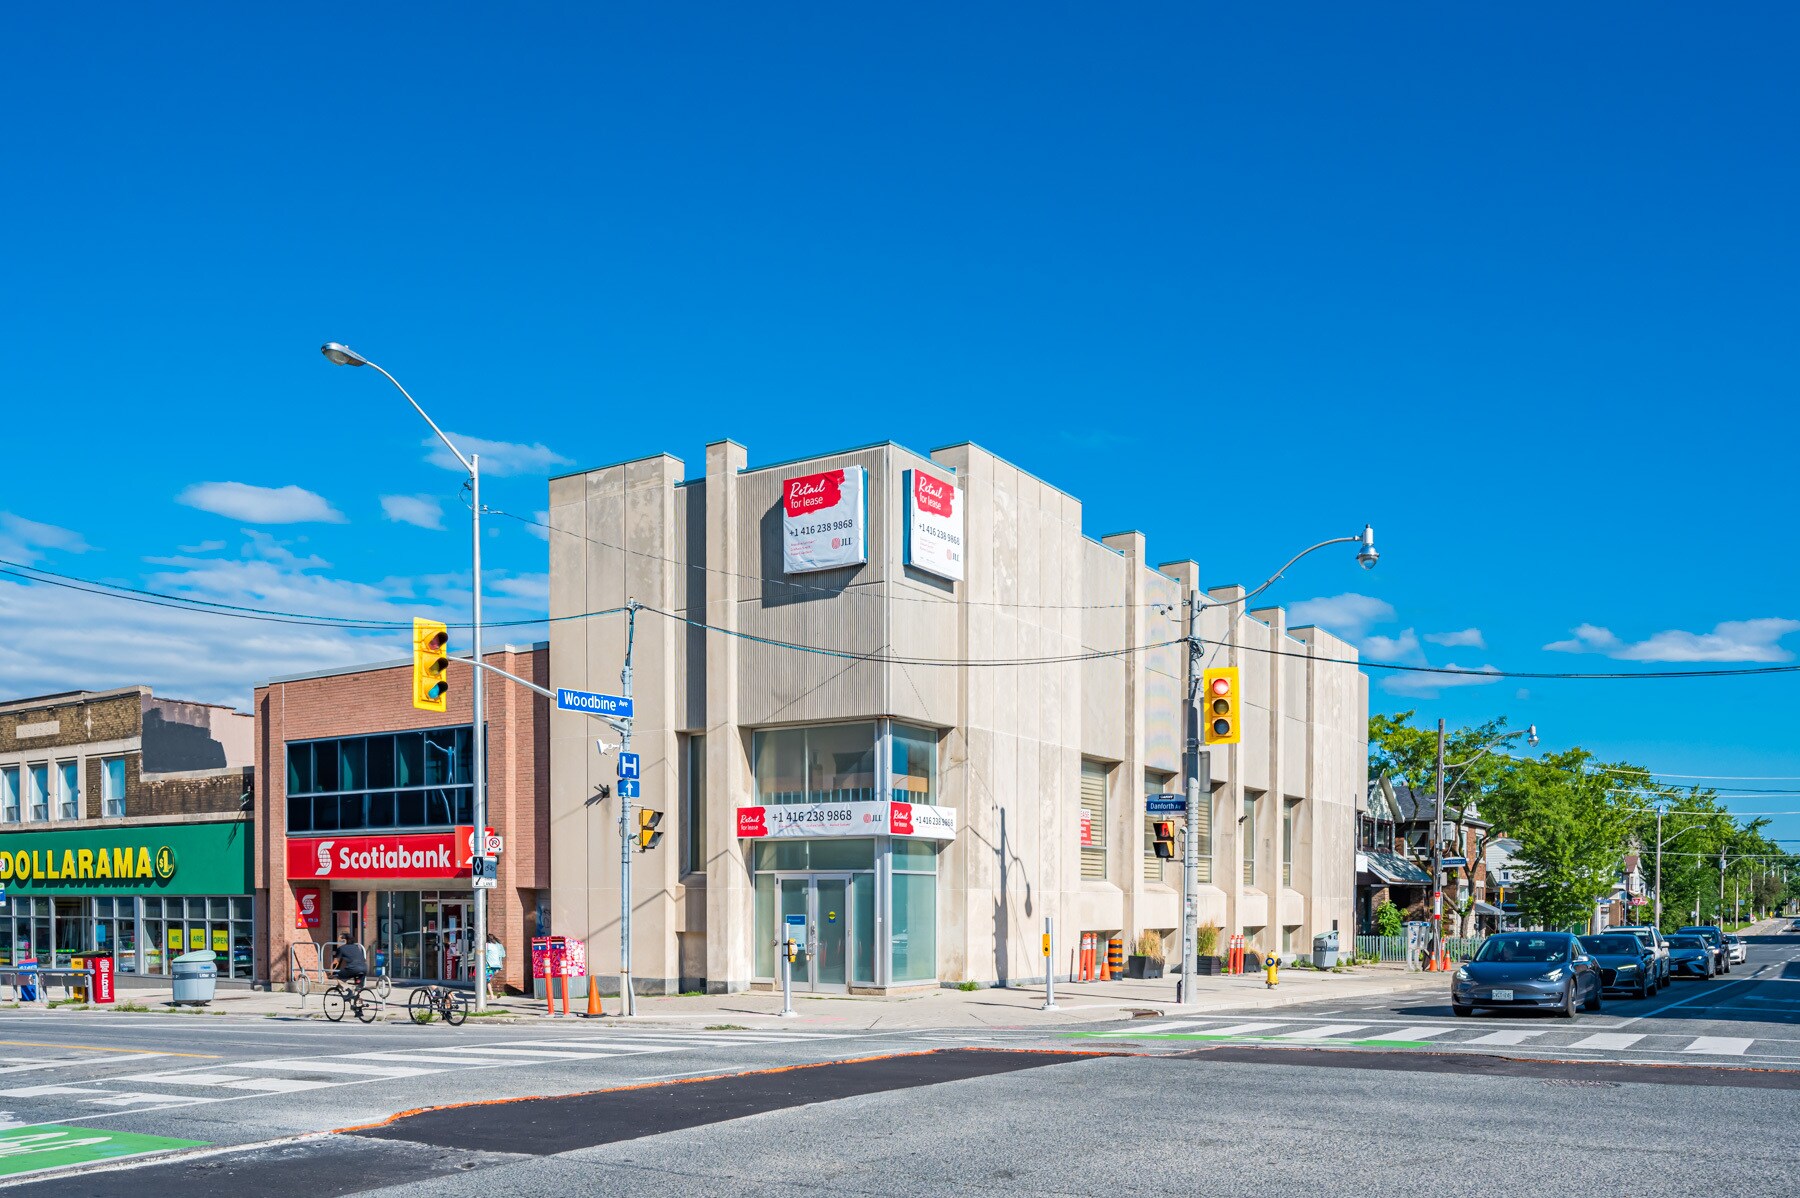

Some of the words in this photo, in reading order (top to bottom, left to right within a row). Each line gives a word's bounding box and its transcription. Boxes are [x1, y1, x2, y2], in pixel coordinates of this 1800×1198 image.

[789, 479, 826, 500] Retail
[918, 476, 943, 499] Retail
[790, 498, 801, 509] for
[803, 496, 824, 507] lease
[919, 492, 928, 504] for
[927, 494, 942, 510] lease
[789, 528, 799, 537] +1
[800, 525, 815, 535] 416
[816, 522, 832, 533] 238
[833, 519, 853, 530] 9868
[918, 523, 926, 532] +1
[925, 525, 937, 537] 416
[936, 529, 947, 541] 238
[840, 537, 852, 546] JLL
[563, 691, 617, 711] Woodbine
[618, 699, 628, 708] Ave
[622, 755, 637, 776] H
[1150, 802, 1175, 810] Danforth
[740, 814, 760, 824] Retail
[772, 812, 783, 822] +1
[786, 811, 804, 822] 416
[806, 811, 825, 821] 238
[827, 810, 852, 821] 9868
[922, 816, 932, 825] 416
[932, 817, 941, 826] 238
[0, 846, 153, 880] DOLLARAMA
[339, 843, 451, 870] Scotiabank
[192, 935, 203, 943] ARE
[213, 936, 228, 944] OPEN
